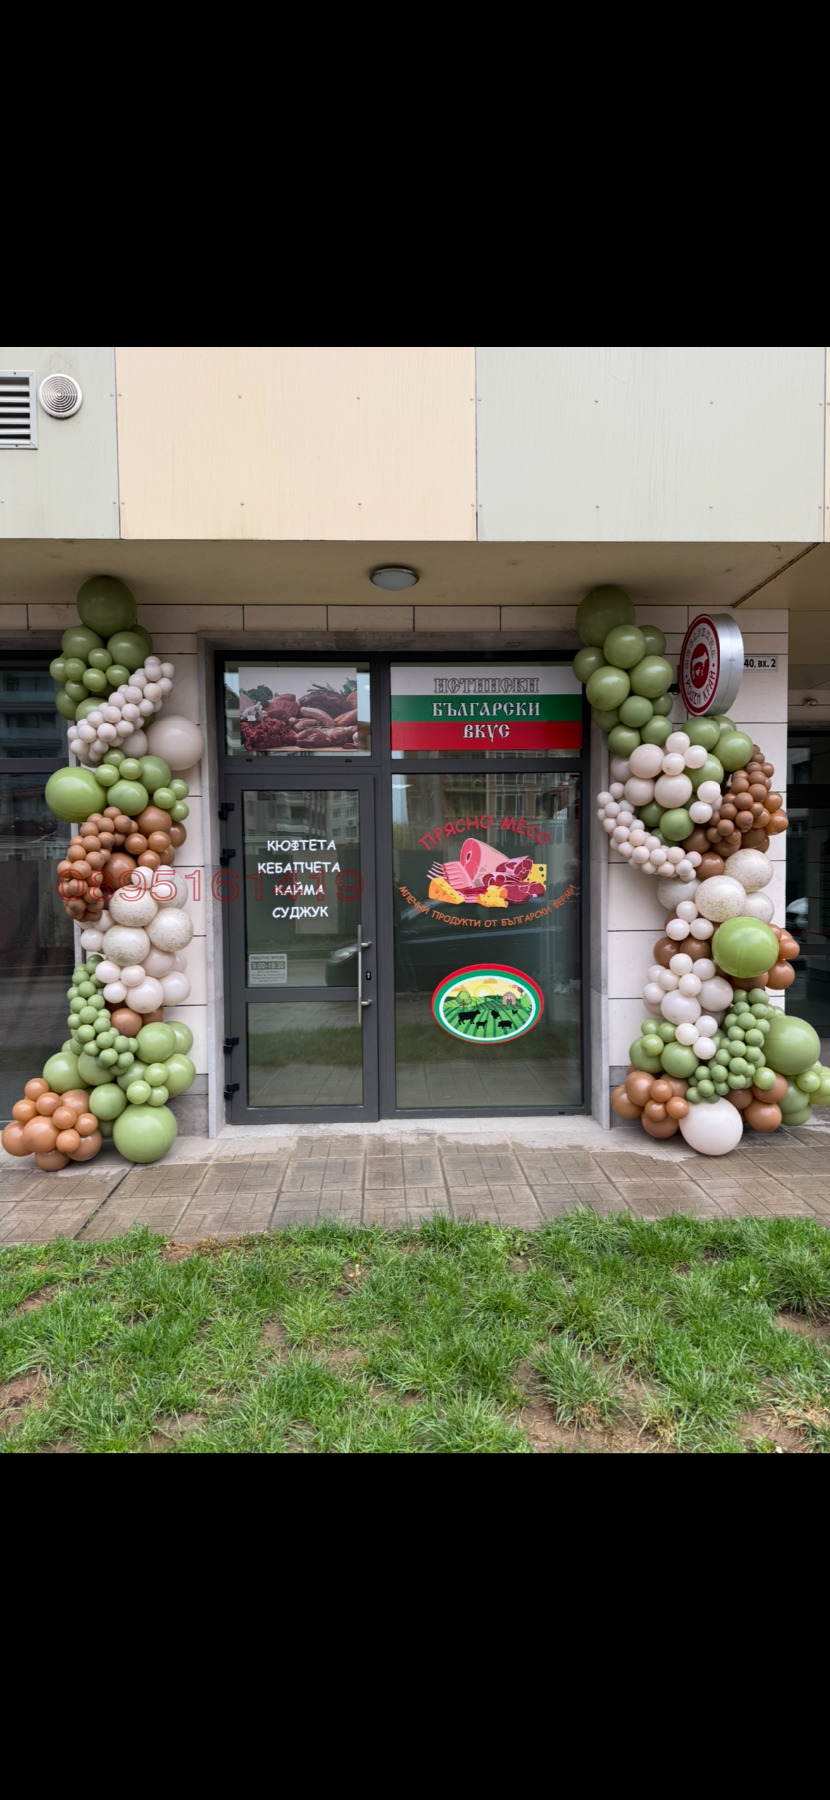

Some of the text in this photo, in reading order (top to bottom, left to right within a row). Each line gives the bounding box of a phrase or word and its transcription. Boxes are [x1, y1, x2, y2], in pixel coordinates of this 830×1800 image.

[771, 658, 776, 668] 2
[433, 678, 540, 694] ИСТИНСКИ
[431, 702, 541, 717] БЪЛГАРСКИ
[463, 723, 511, 743] ВКУС
[418, 814, 551, 851] ПРЯСНО МЕСО
[267, 839, 337, 852] КЮФТЕТА
[257, 861, 341, 874] КЕБАПЧЕТА
[274, 881, 325, 896] КАЙМА
[272, 906, 329, 920] СУДЖУК
[398, 884, 577, 928] МЛЕЧНИ ПРОДУКТИ ОТ БЪЛГАРСКИ ФЕРМИ
